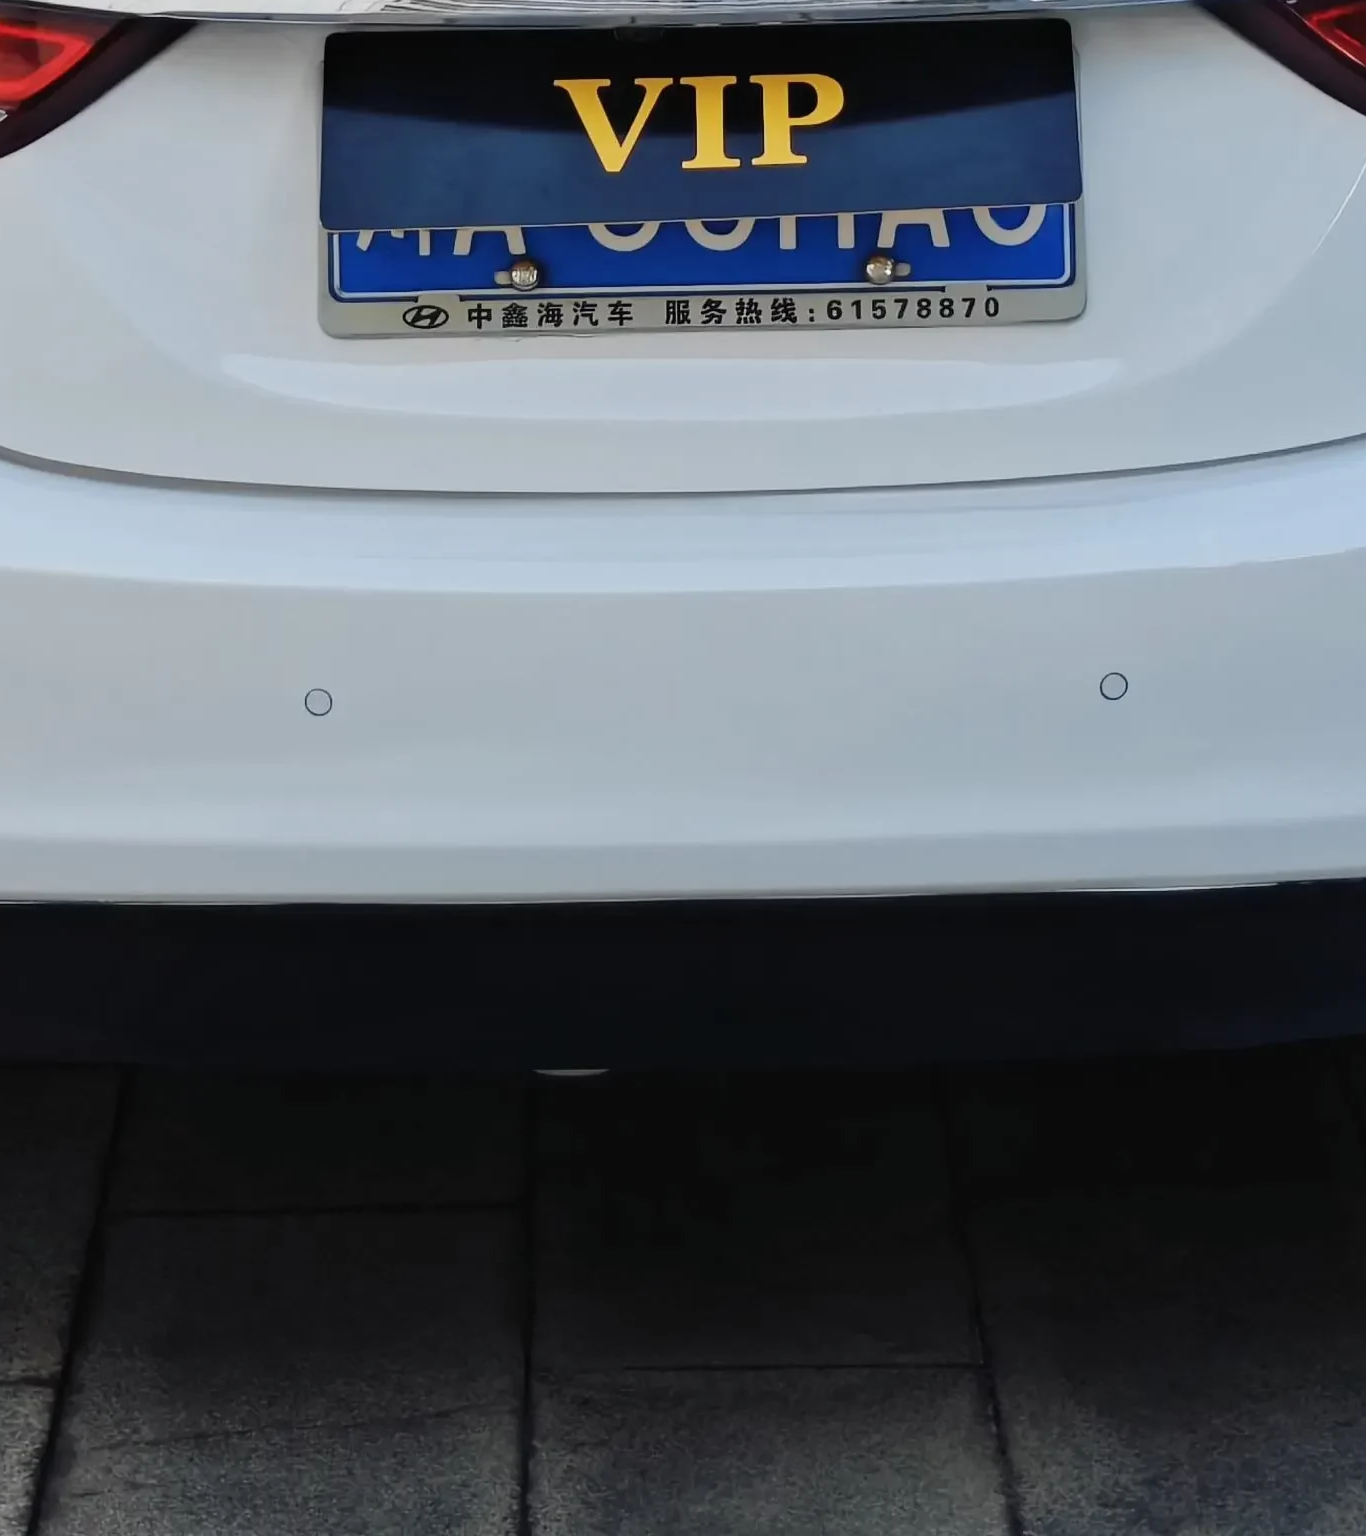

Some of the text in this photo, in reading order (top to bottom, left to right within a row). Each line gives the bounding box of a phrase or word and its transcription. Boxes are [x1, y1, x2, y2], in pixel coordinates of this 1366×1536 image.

[553, 72, 847, 173] VIP
[466, 294, 1002, 330] 中鑫海汽车 服务热线:61578870
